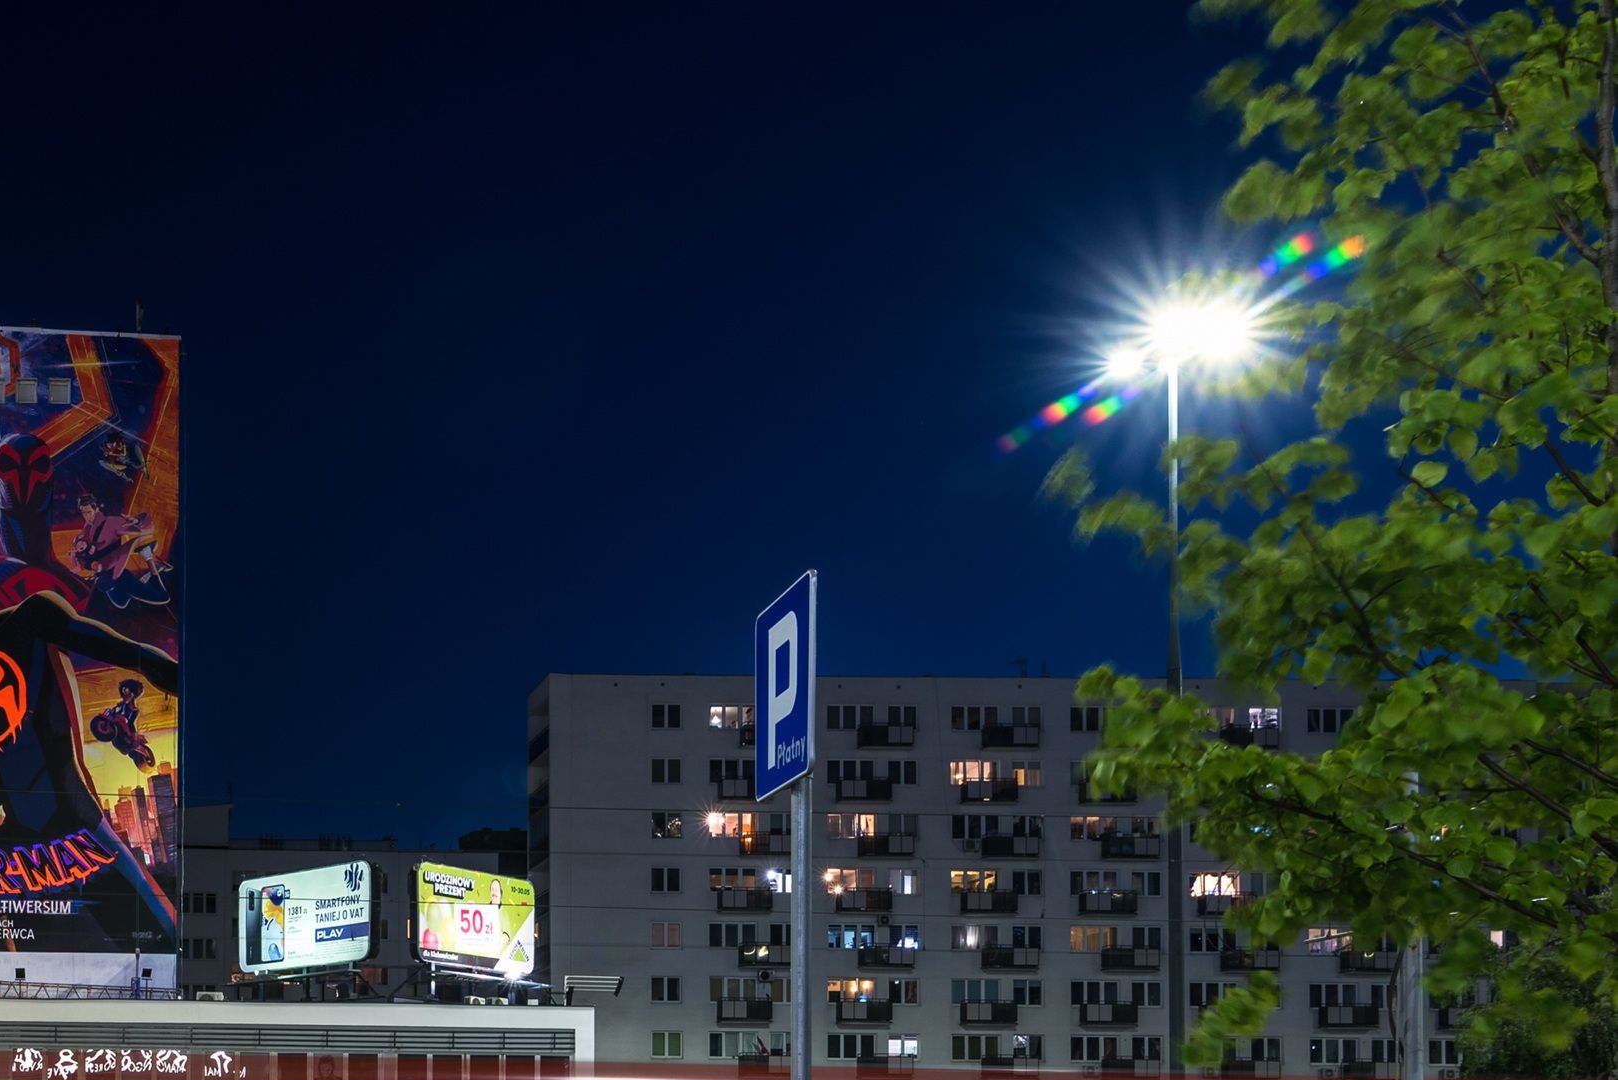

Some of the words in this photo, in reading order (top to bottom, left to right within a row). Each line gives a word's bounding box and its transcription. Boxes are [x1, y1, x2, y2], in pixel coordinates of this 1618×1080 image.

[767, 610, 798, 771] P
[777, 735, 806, 770] Płatny
[424, 870, 475, 889] URODZINOWY
[434, 882, 466, 897] PREZENT
[288, 906, 302, 917] 1381
[315, 895, 361, 911] SMARTFONY
[315, 910, 341, 924] TANIEJ
[342, 909, 348, 920] O
[349, 907, 364, 919] VAT
[460, 909, 483, 934] 50
[485, 921, 494, 934] zł
[316, 927, 344, 940] PLAY
